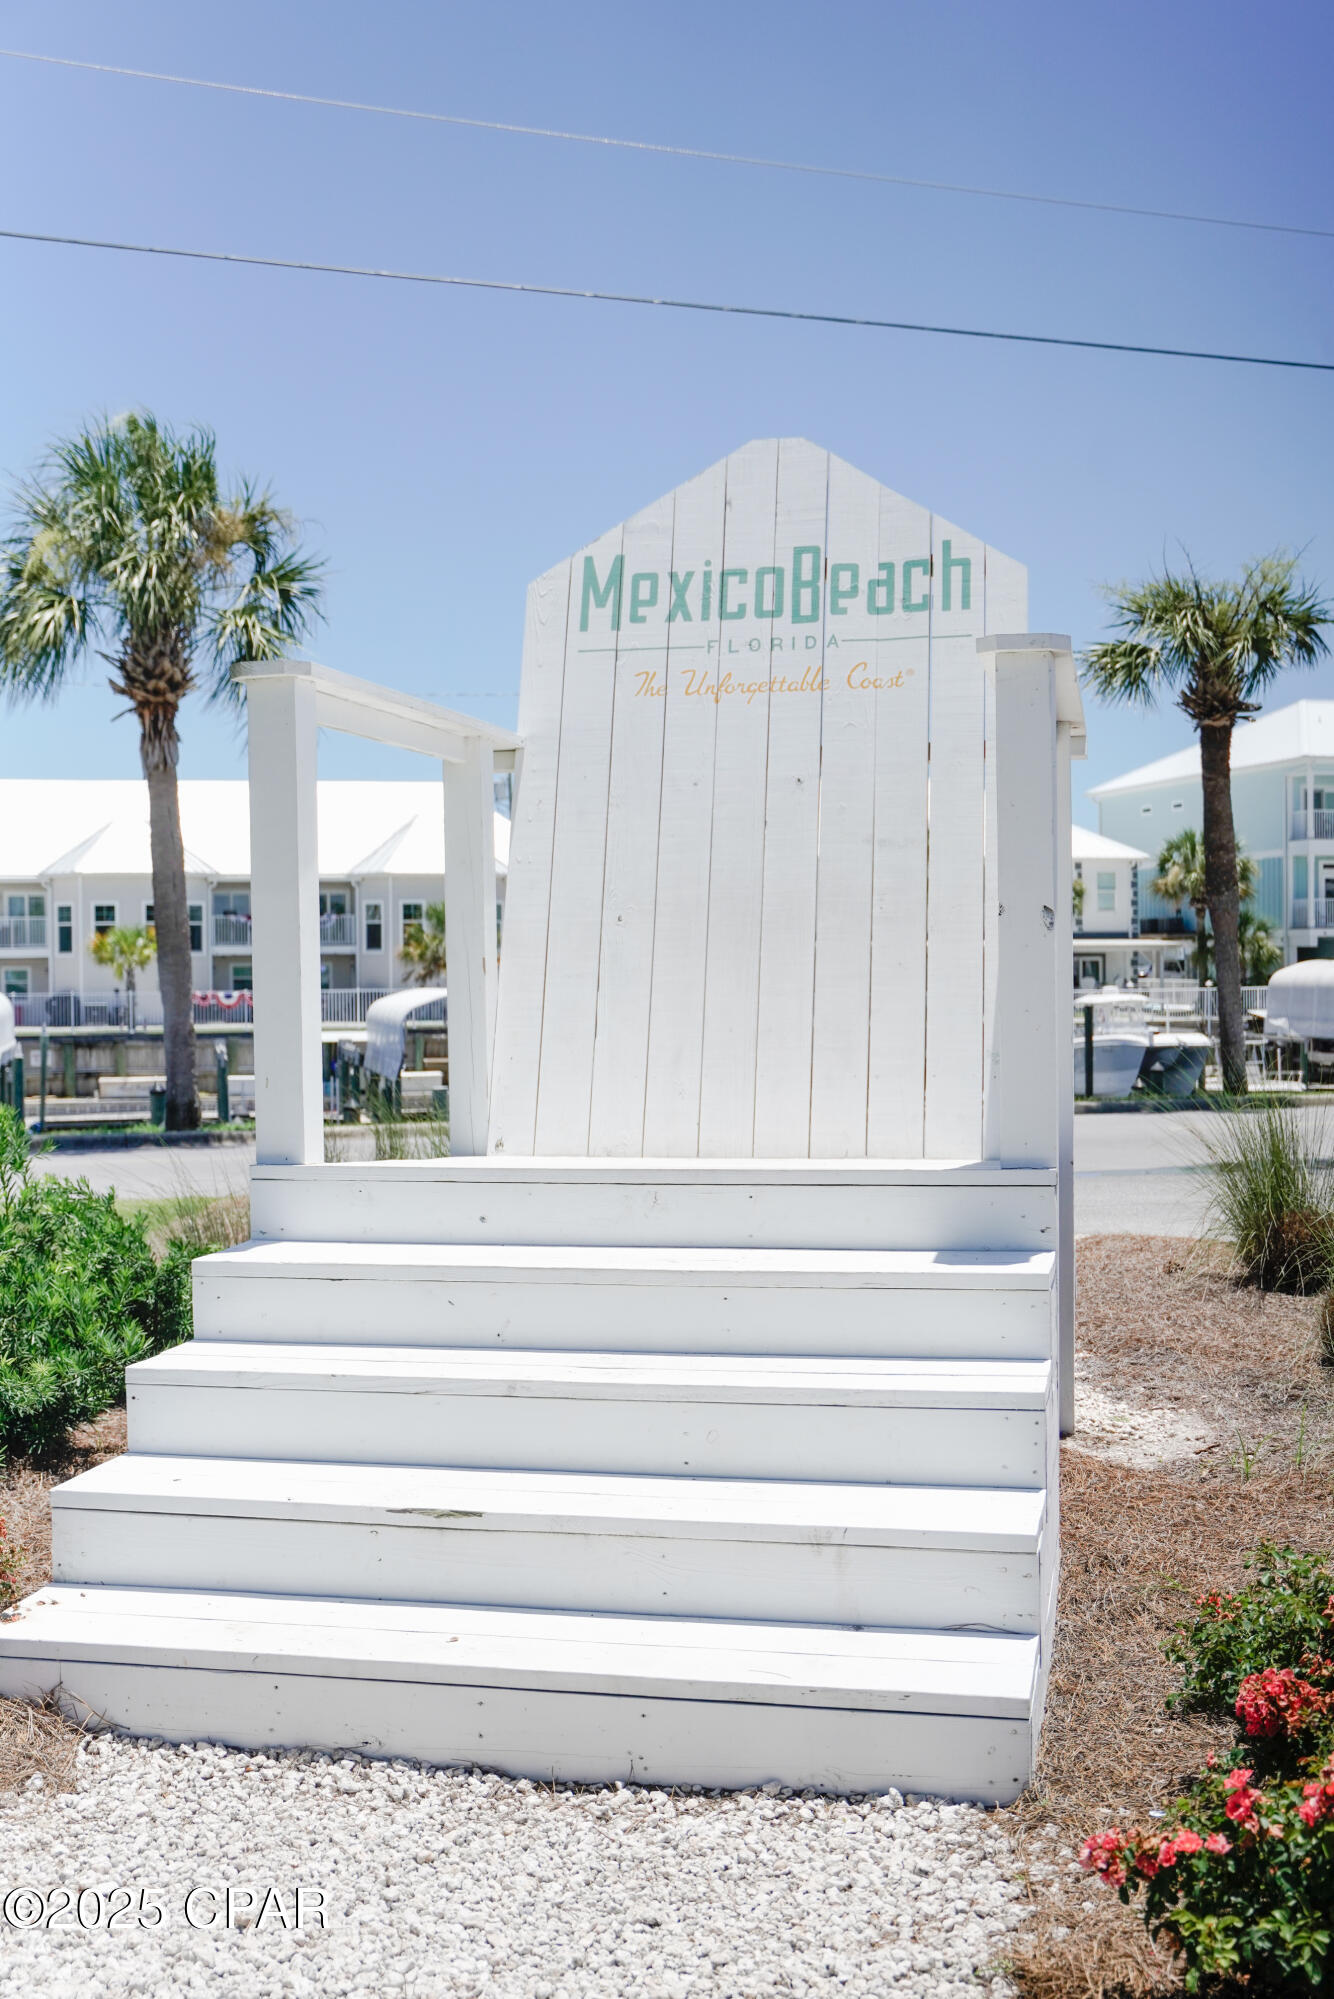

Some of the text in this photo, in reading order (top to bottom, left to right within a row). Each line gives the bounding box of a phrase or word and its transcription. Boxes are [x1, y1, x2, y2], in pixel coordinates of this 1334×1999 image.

[706, 634, 840, 654] FLORIDA
[634, 670, 668, 698] The
[680, 665, 830, 704] Unforgettable
